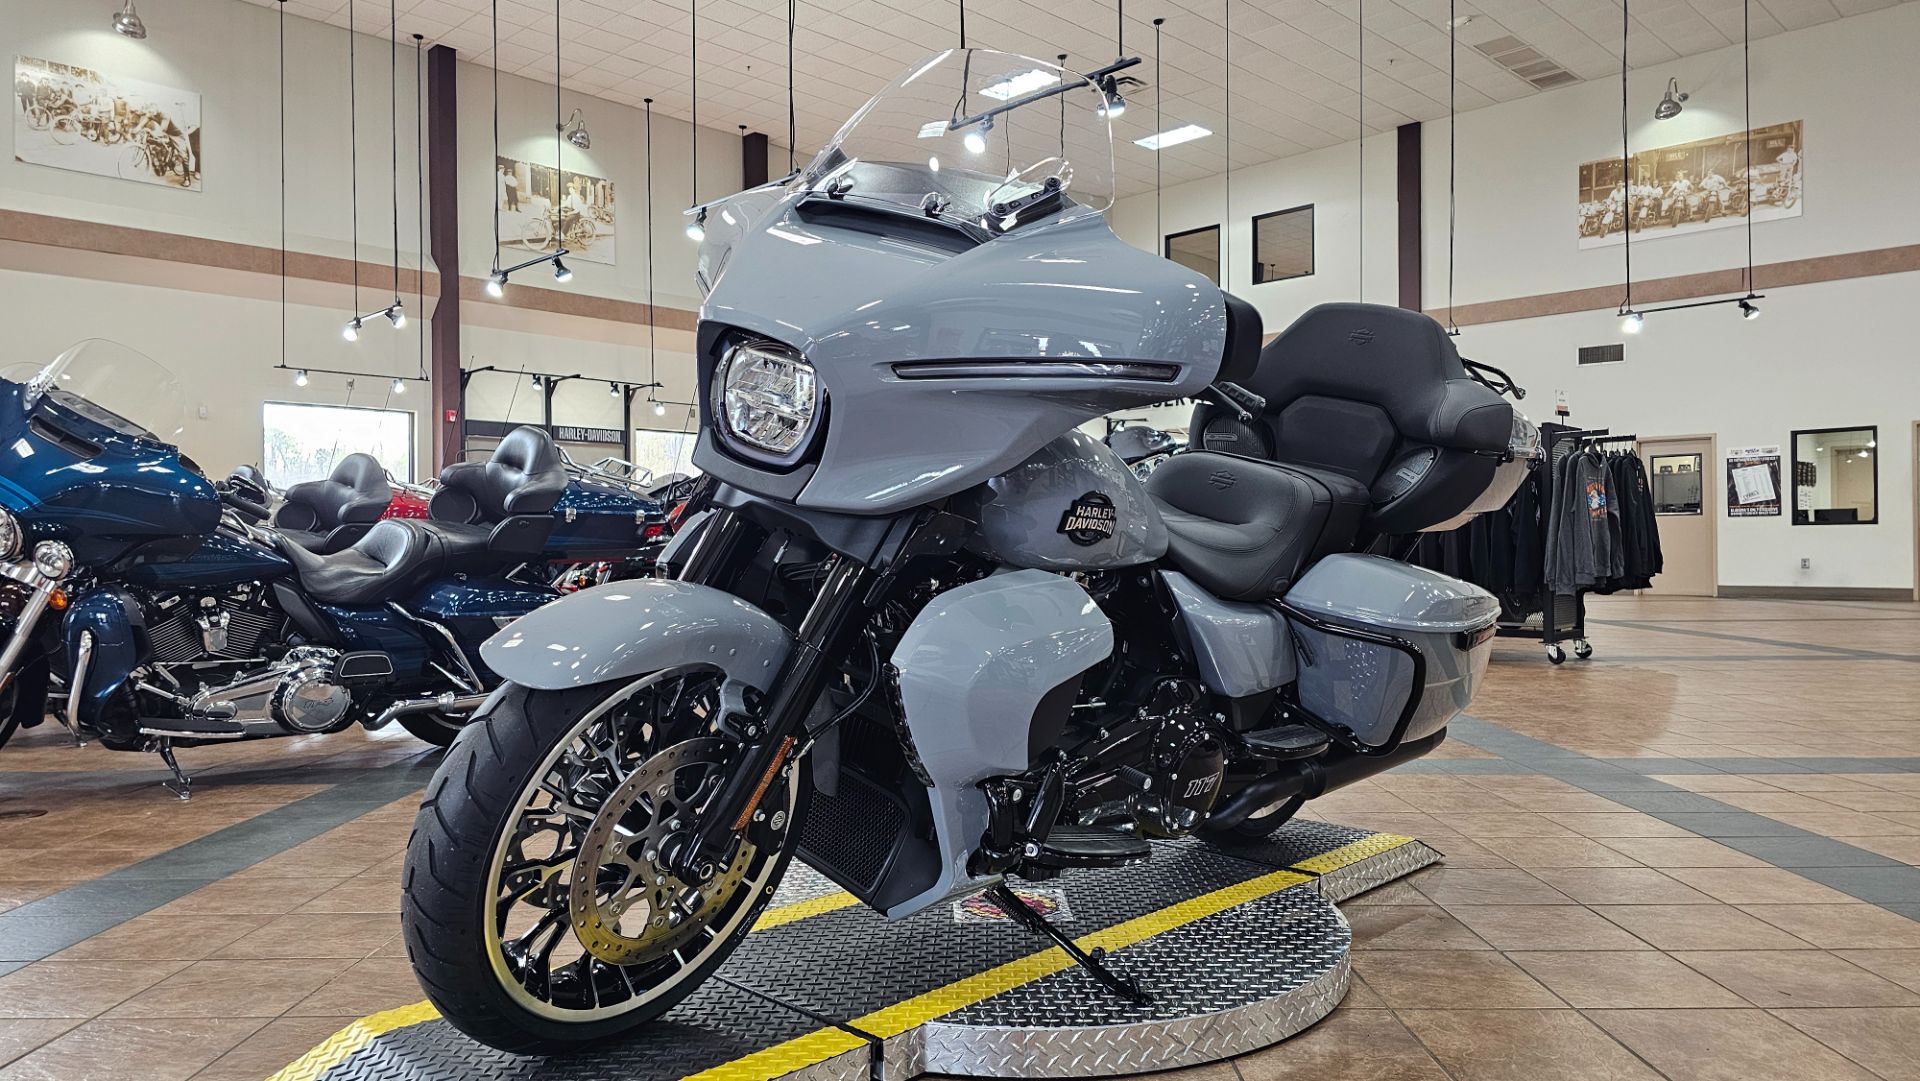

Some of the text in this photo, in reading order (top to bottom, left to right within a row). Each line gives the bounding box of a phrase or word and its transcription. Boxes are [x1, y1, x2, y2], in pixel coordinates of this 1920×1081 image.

[559, 427, 621, 443] HARLEY-DAVIDSON
[1065, 516, 1116, 535] DAVIDSON
[1184, 772, 1220, 798] 117
